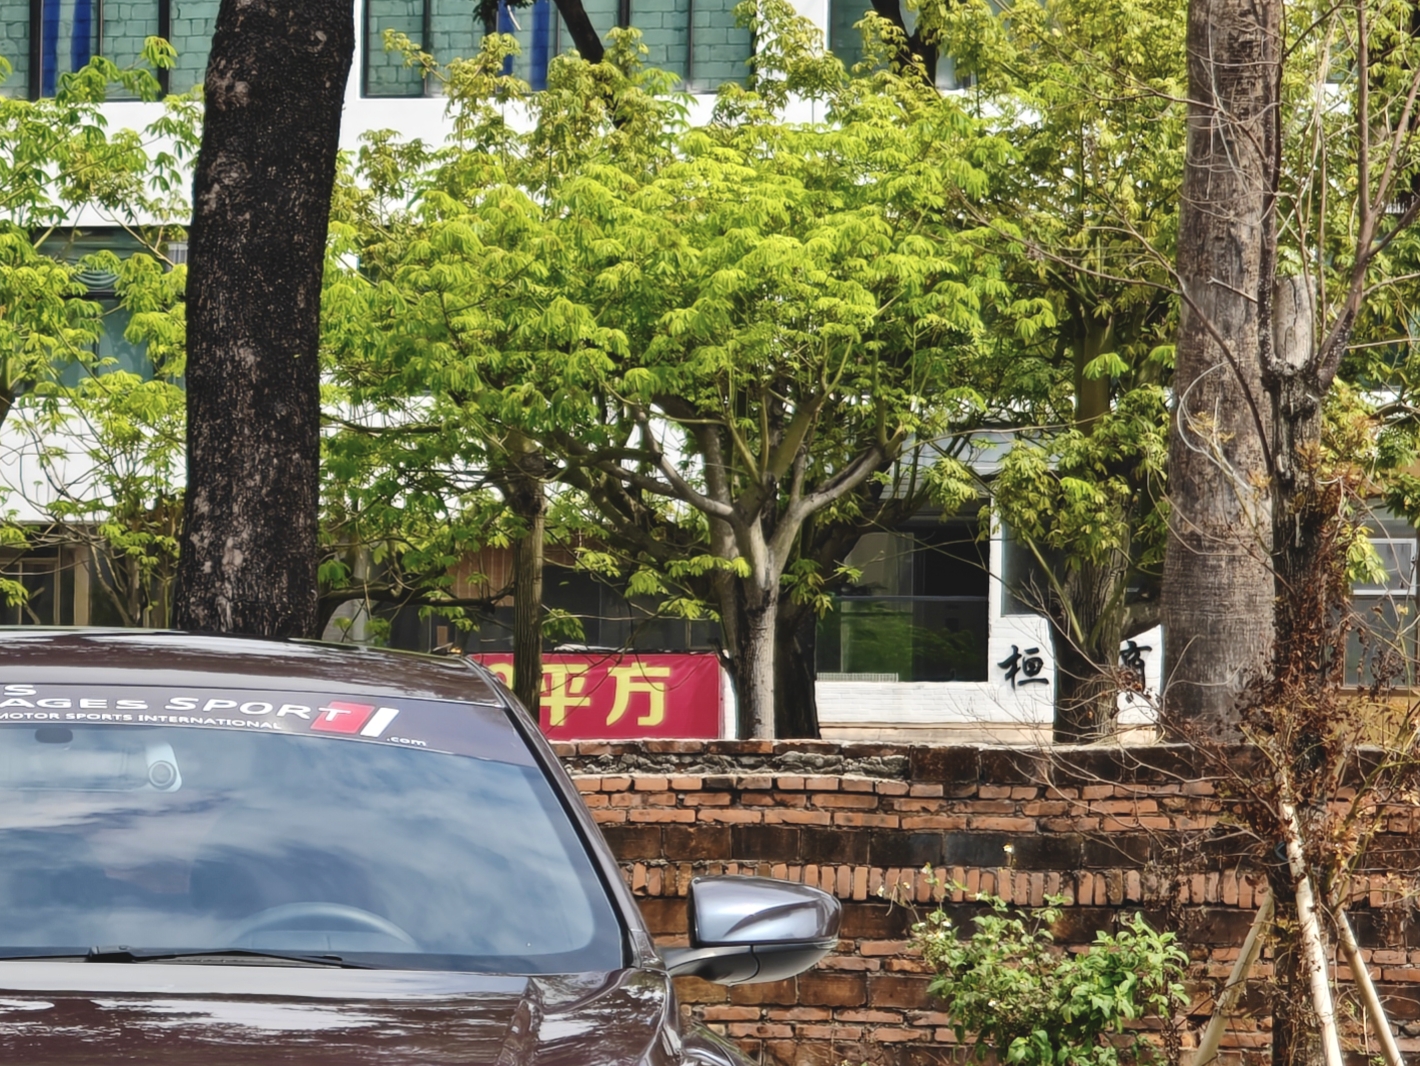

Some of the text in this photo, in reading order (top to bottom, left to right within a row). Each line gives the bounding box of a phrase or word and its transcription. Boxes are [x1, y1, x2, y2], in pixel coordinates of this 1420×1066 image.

[165, 697, 352, 722] SPORT
[65, 712, 133, 721] SPORTS
[138, 714, 282, 730] INTERNATIONAL
